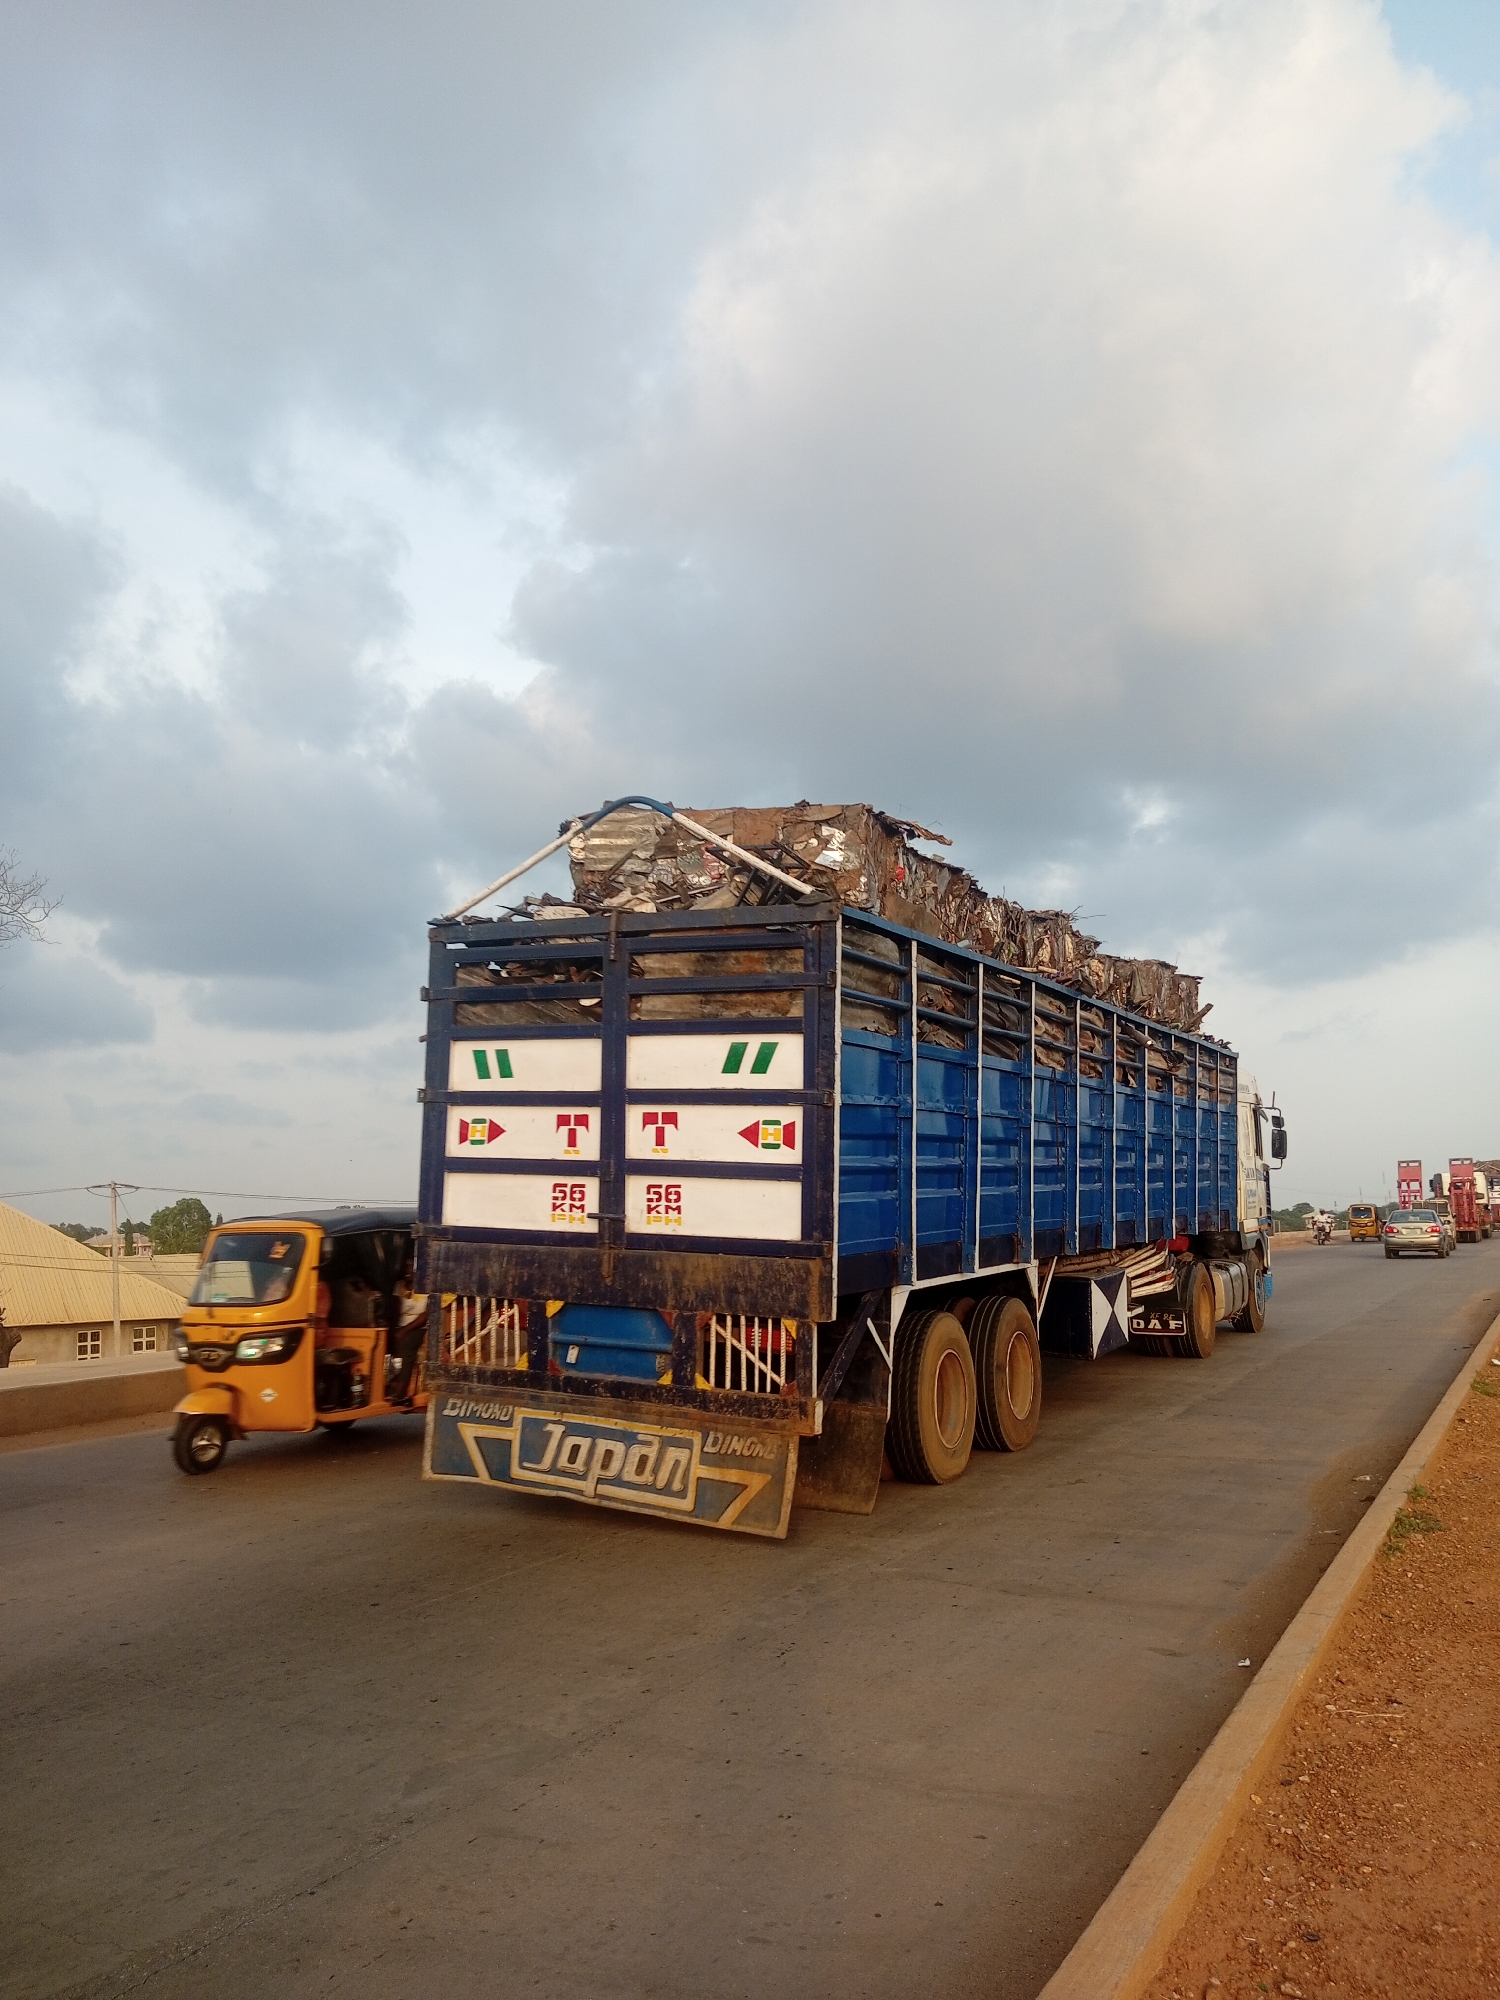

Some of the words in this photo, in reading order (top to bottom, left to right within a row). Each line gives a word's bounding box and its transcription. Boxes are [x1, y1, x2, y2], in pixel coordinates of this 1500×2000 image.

[552, 1183, 585, 1201] 56
[646, 1184, 681, 1203] 56
[552, 1202, 585, 1213] KM
[646, 1204, 681, 1215] KM
[1132, 1319, 1183, 1329] DAF
[442, 1398, 513, 1421] DIMOND
[522, 1422, 692, 1498] Japan
